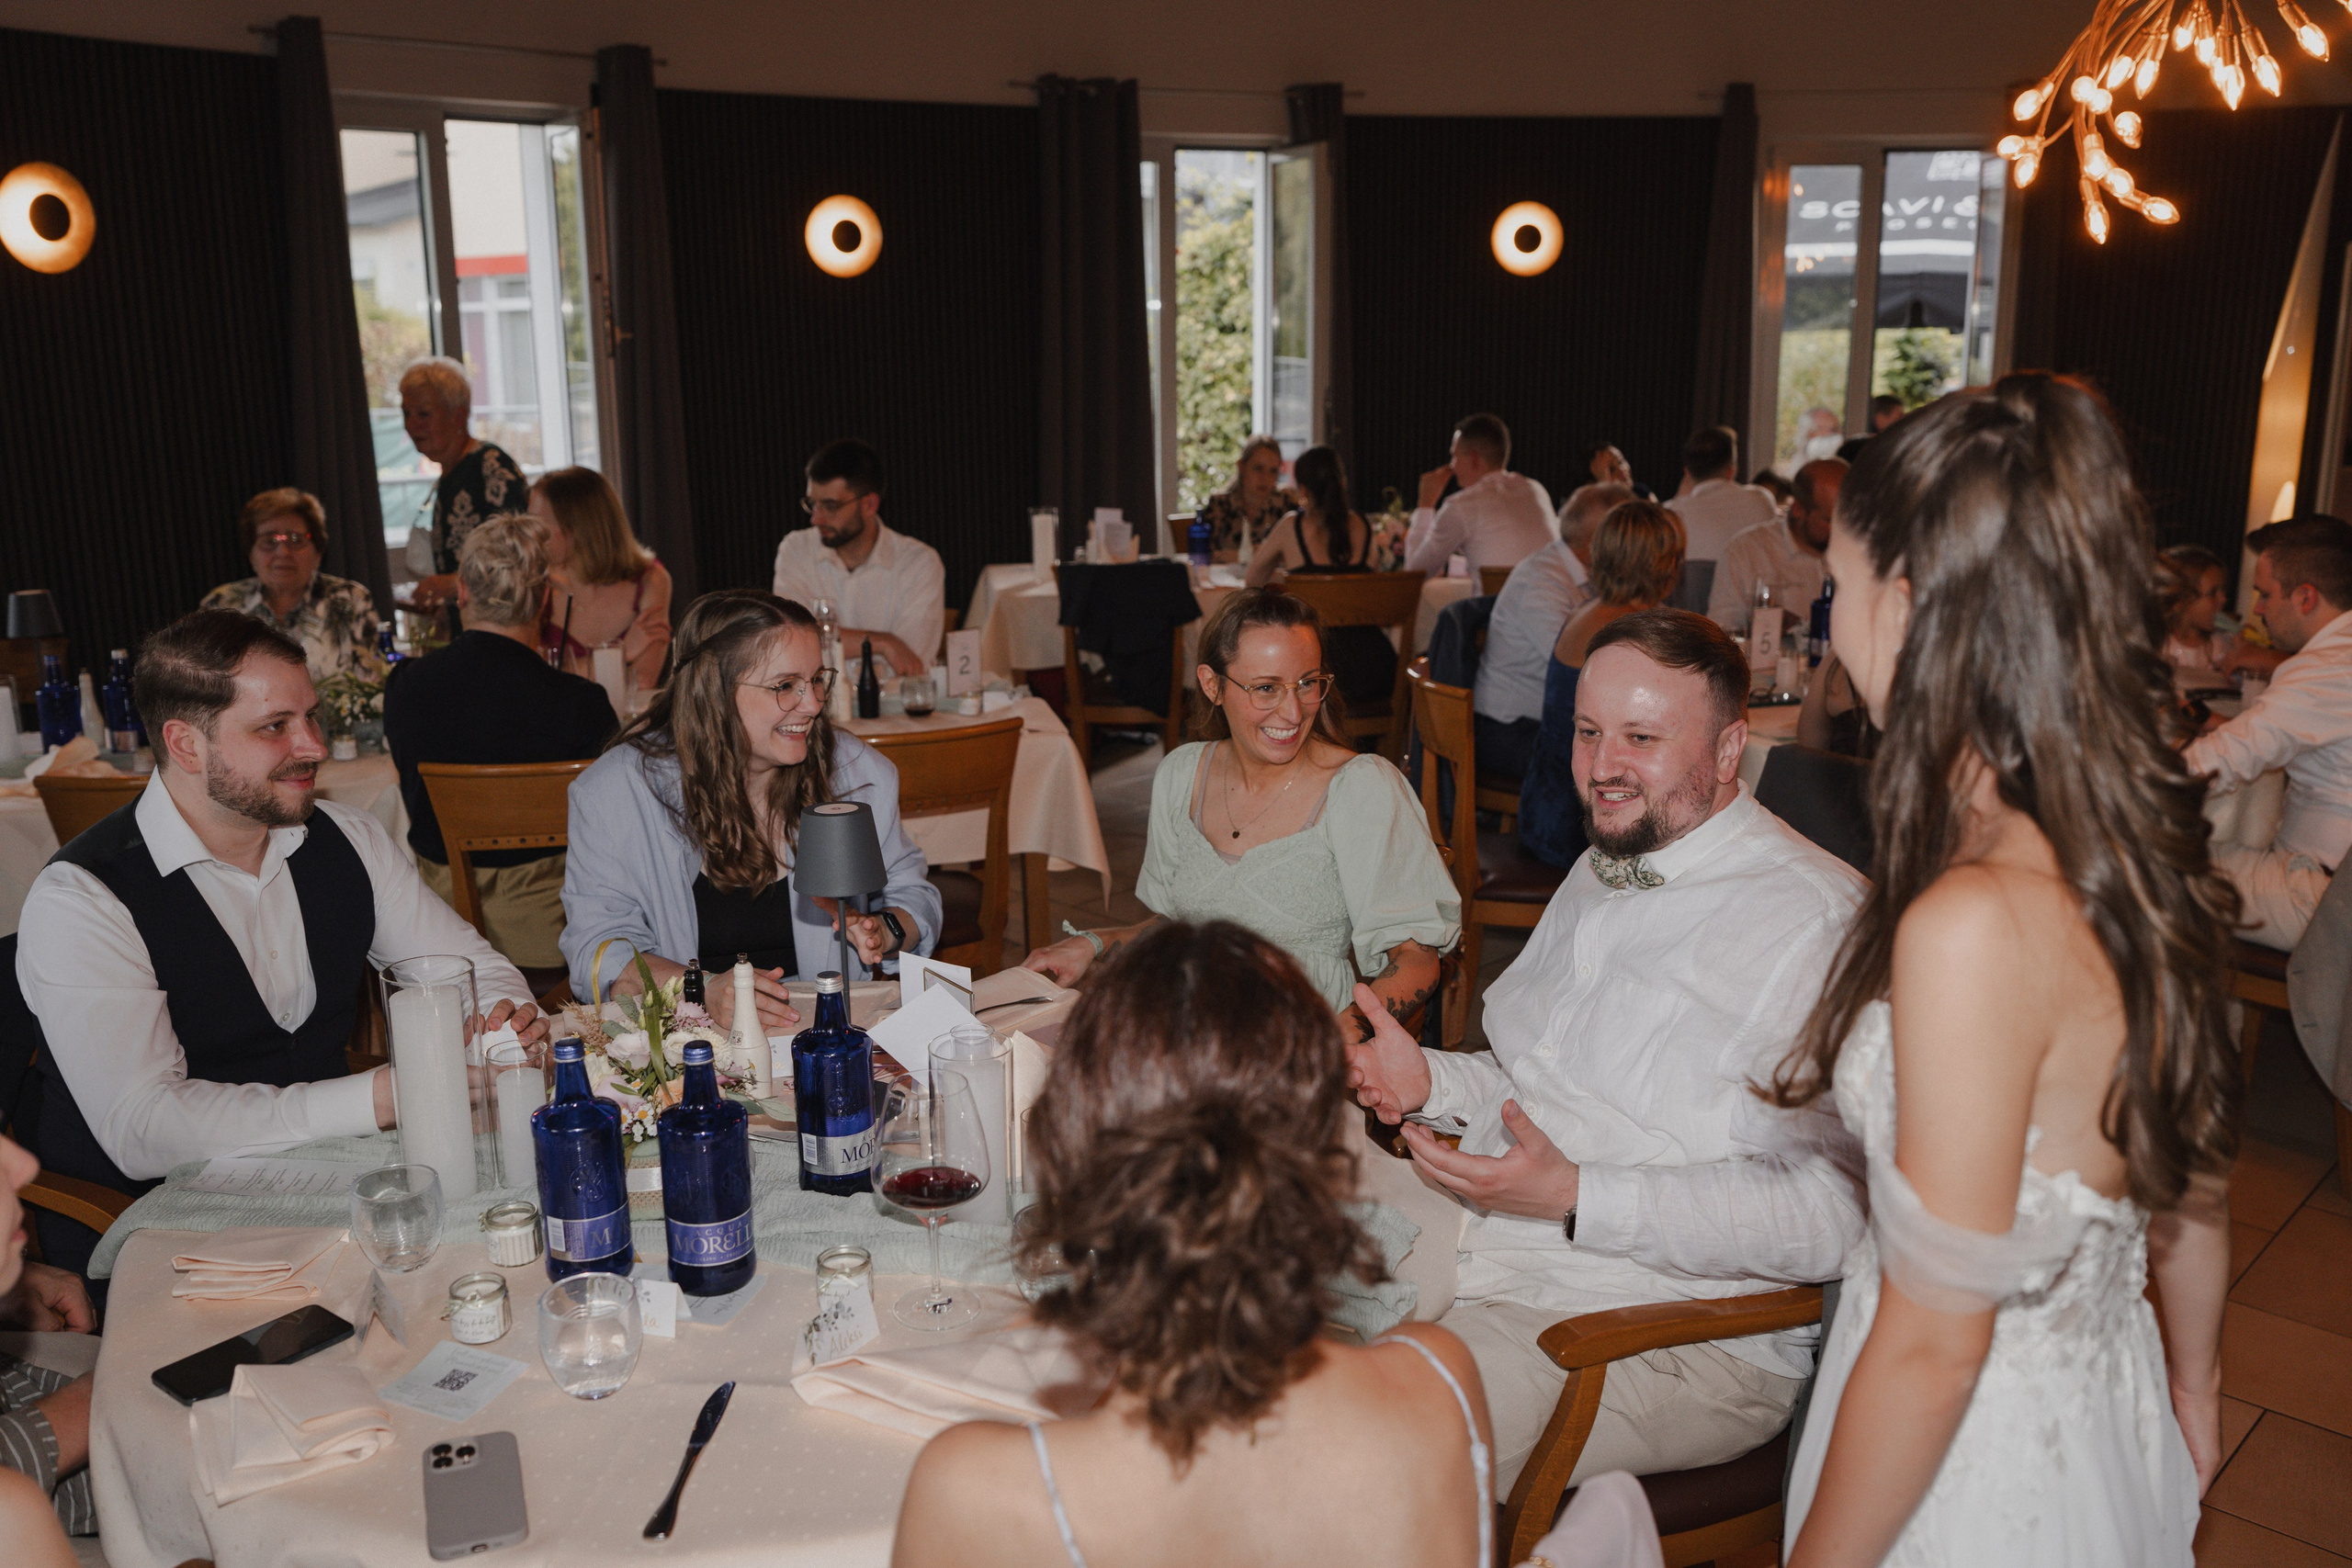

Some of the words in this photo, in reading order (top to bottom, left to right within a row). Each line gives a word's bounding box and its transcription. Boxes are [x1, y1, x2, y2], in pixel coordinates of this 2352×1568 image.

[1836, 216, 1976, 232] POSE
[1759, 632, 1771, 654] 5
[958, 655, 970, 675] 2
[695, 1221, 743, 1236] ACQUA
[673, 1224, 753, 1255] MORELL
